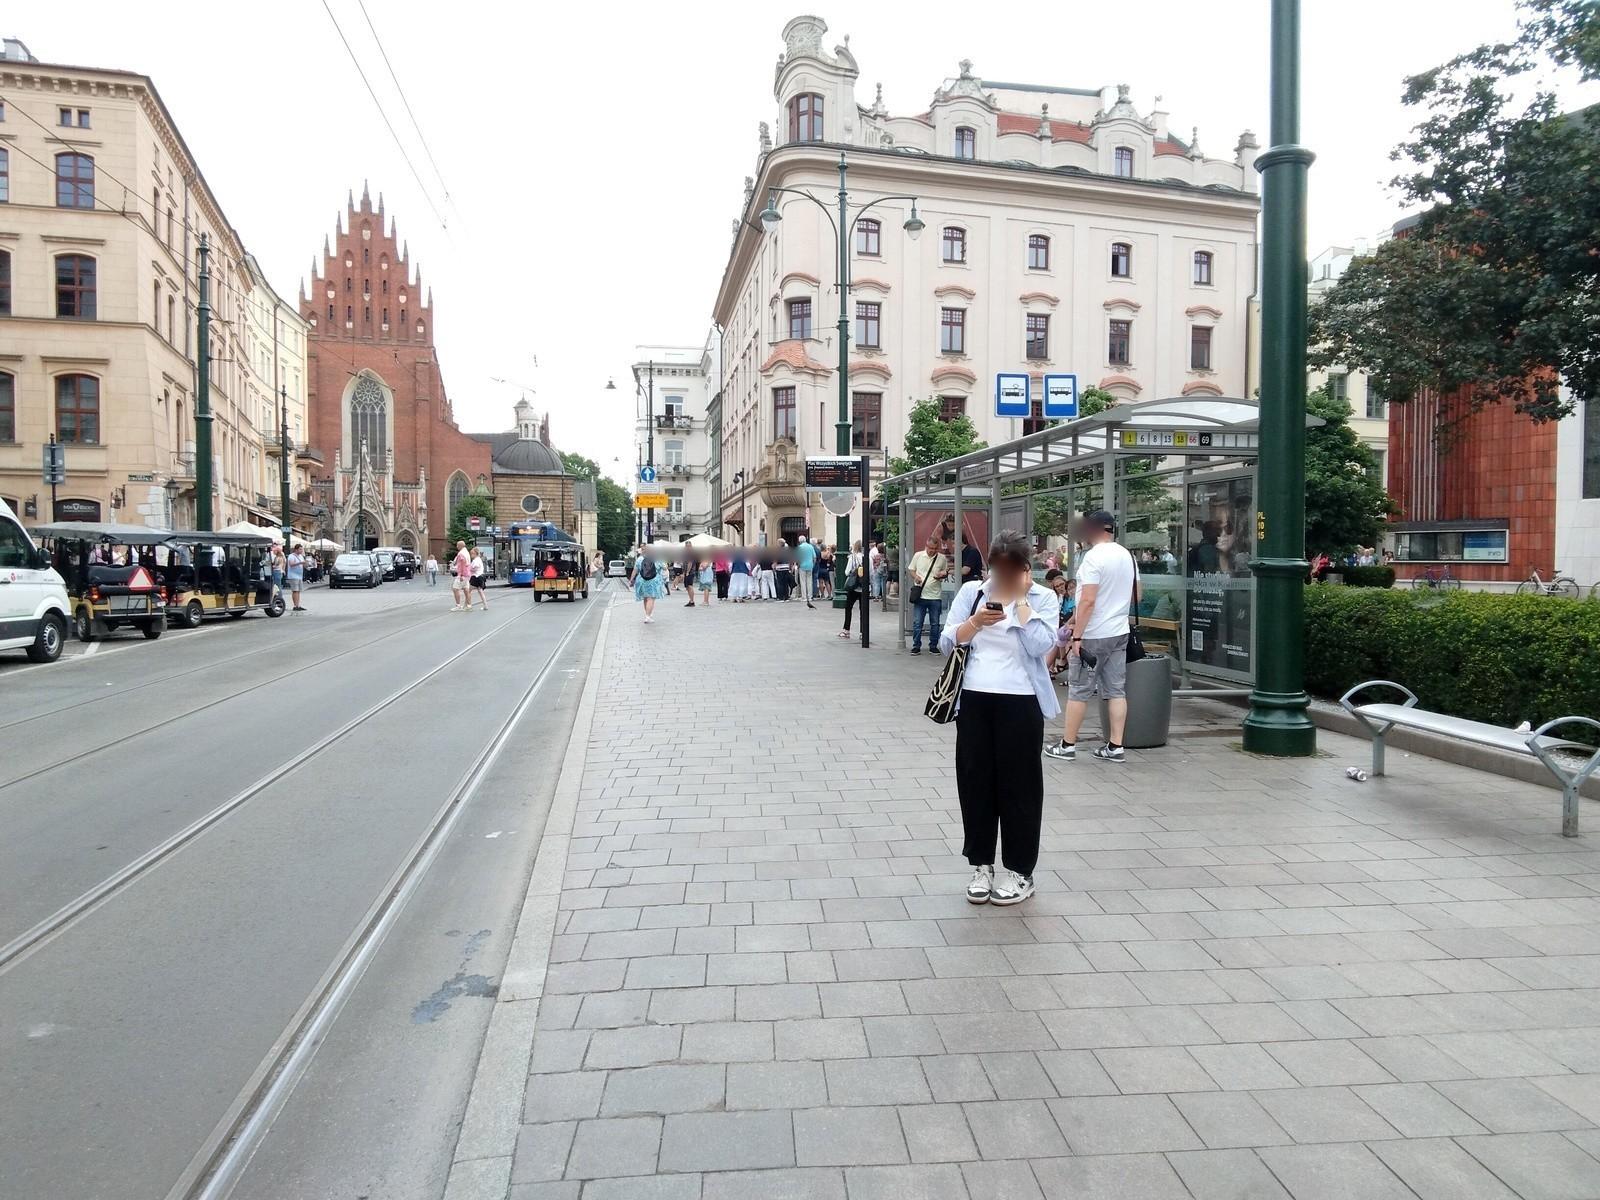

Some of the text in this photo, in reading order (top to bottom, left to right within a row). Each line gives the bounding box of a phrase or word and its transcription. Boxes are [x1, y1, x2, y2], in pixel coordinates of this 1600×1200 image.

[1164, 435, 1172, 443] 13
[1189, 436, 1197, 444] 66
[1201, 435, 1210, 444] 69
